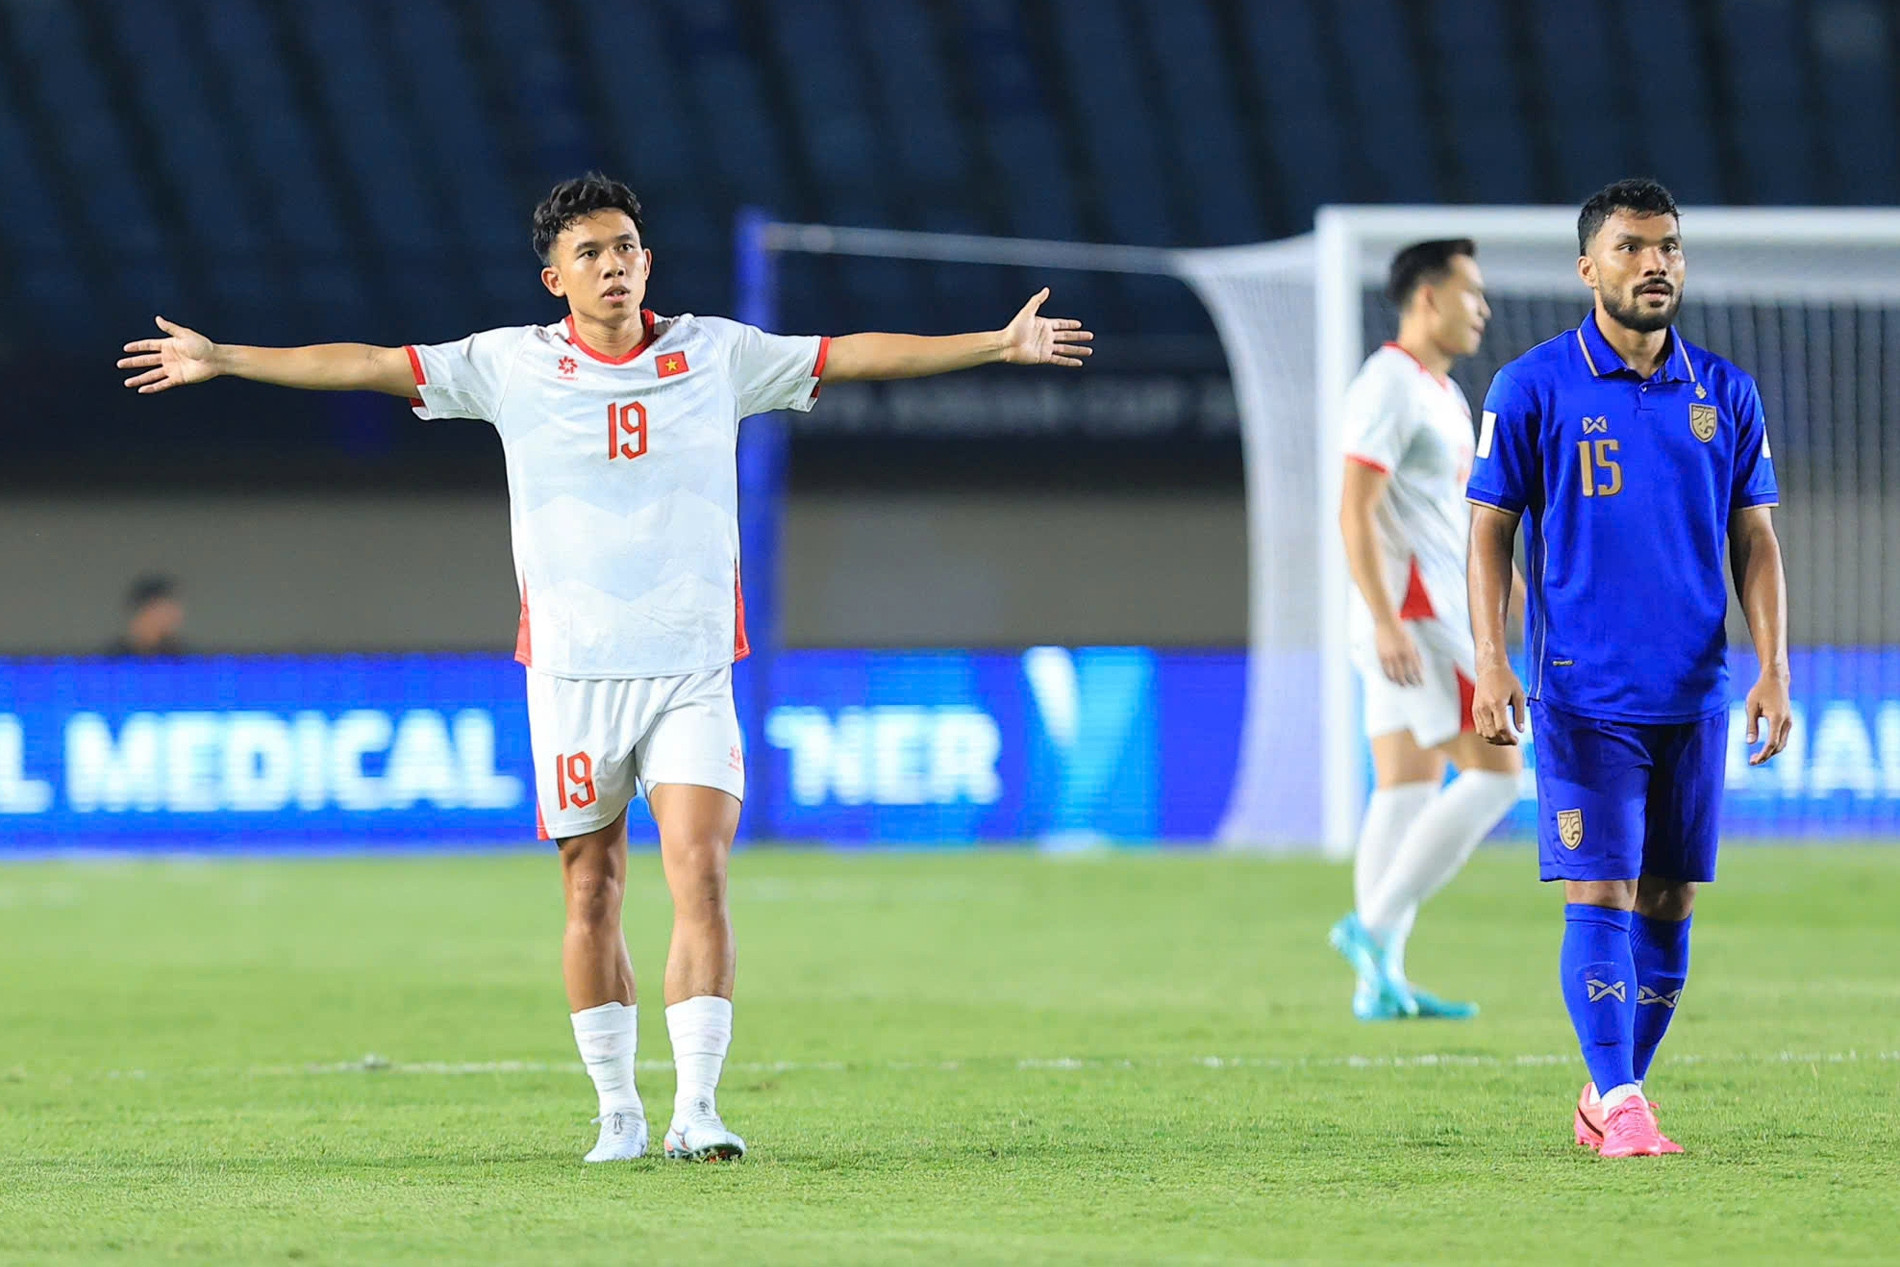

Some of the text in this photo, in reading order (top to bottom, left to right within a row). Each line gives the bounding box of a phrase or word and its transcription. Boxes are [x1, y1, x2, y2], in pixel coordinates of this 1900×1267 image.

[606, 400, 649, 461] 19
[1577, 438, 1623, 498] 15
[64, 707, 524, 814] MEDICAL
[556, 750, 598, 811] 19
